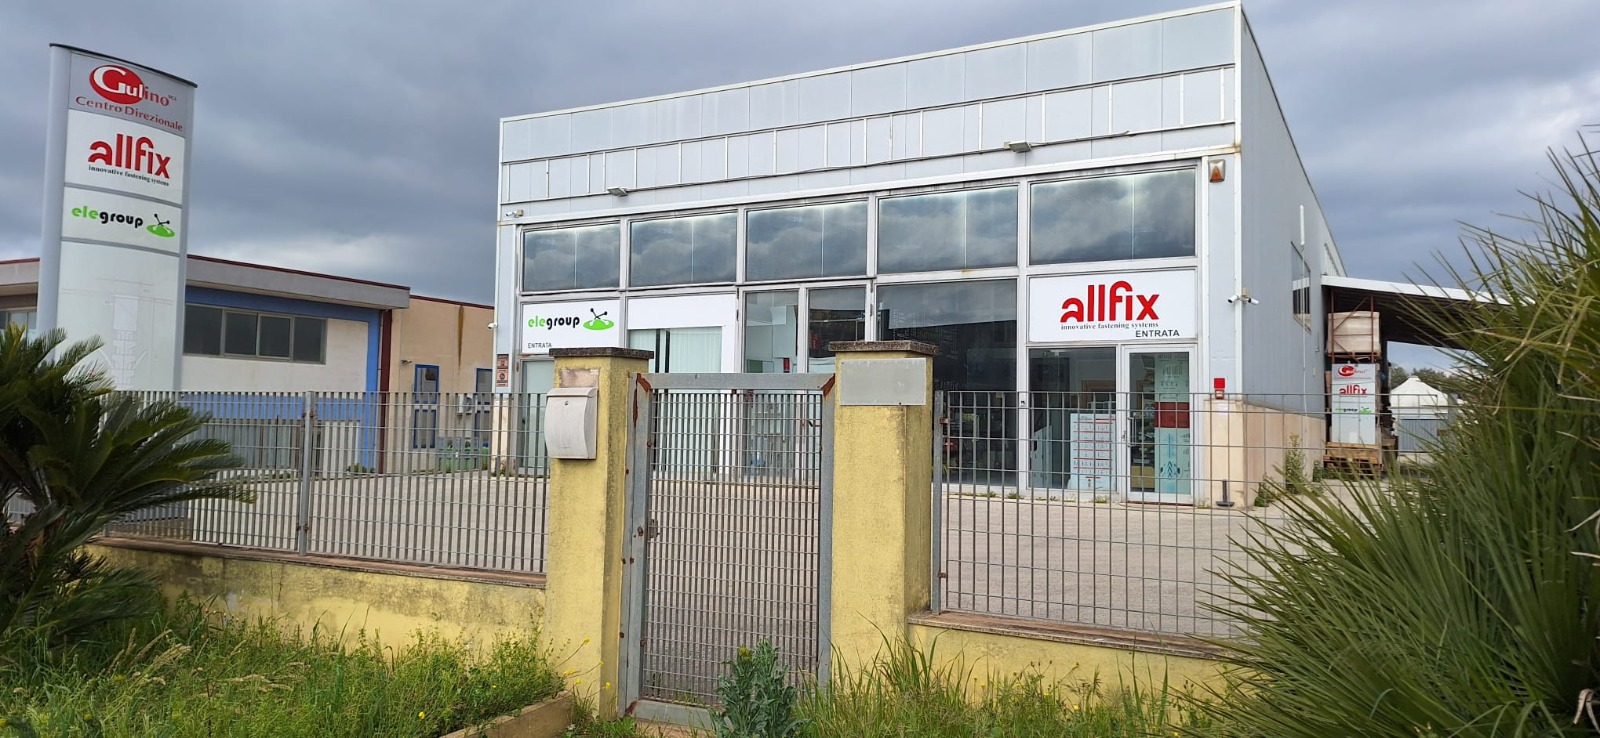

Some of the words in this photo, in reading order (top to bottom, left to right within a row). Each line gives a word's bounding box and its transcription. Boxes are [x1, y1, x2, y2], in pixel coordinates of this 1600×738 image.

[93, 66, 170, 107] Gulino
[76, 96, 122, 113] Centro
[124, 106, 183, 131] Direzionale
[88, 133, 171, 179] allfix
[88, 165, 123, 176] innovative
[124, 170, 151, 183] fastening
[71, 205, 144, 229] elegroup
[1060, 280, 1160, 323] allfix
[528, 315, 580, 331] elegroup
[1061, 323, 1096, 331] innovative
[1098, 322, 1130, 330] fastening
[1131, 321, 1159, 330] systems
[1135, 329, 1180, 338] ENTRATA
[1339, 384, 1368, 395] allfix
